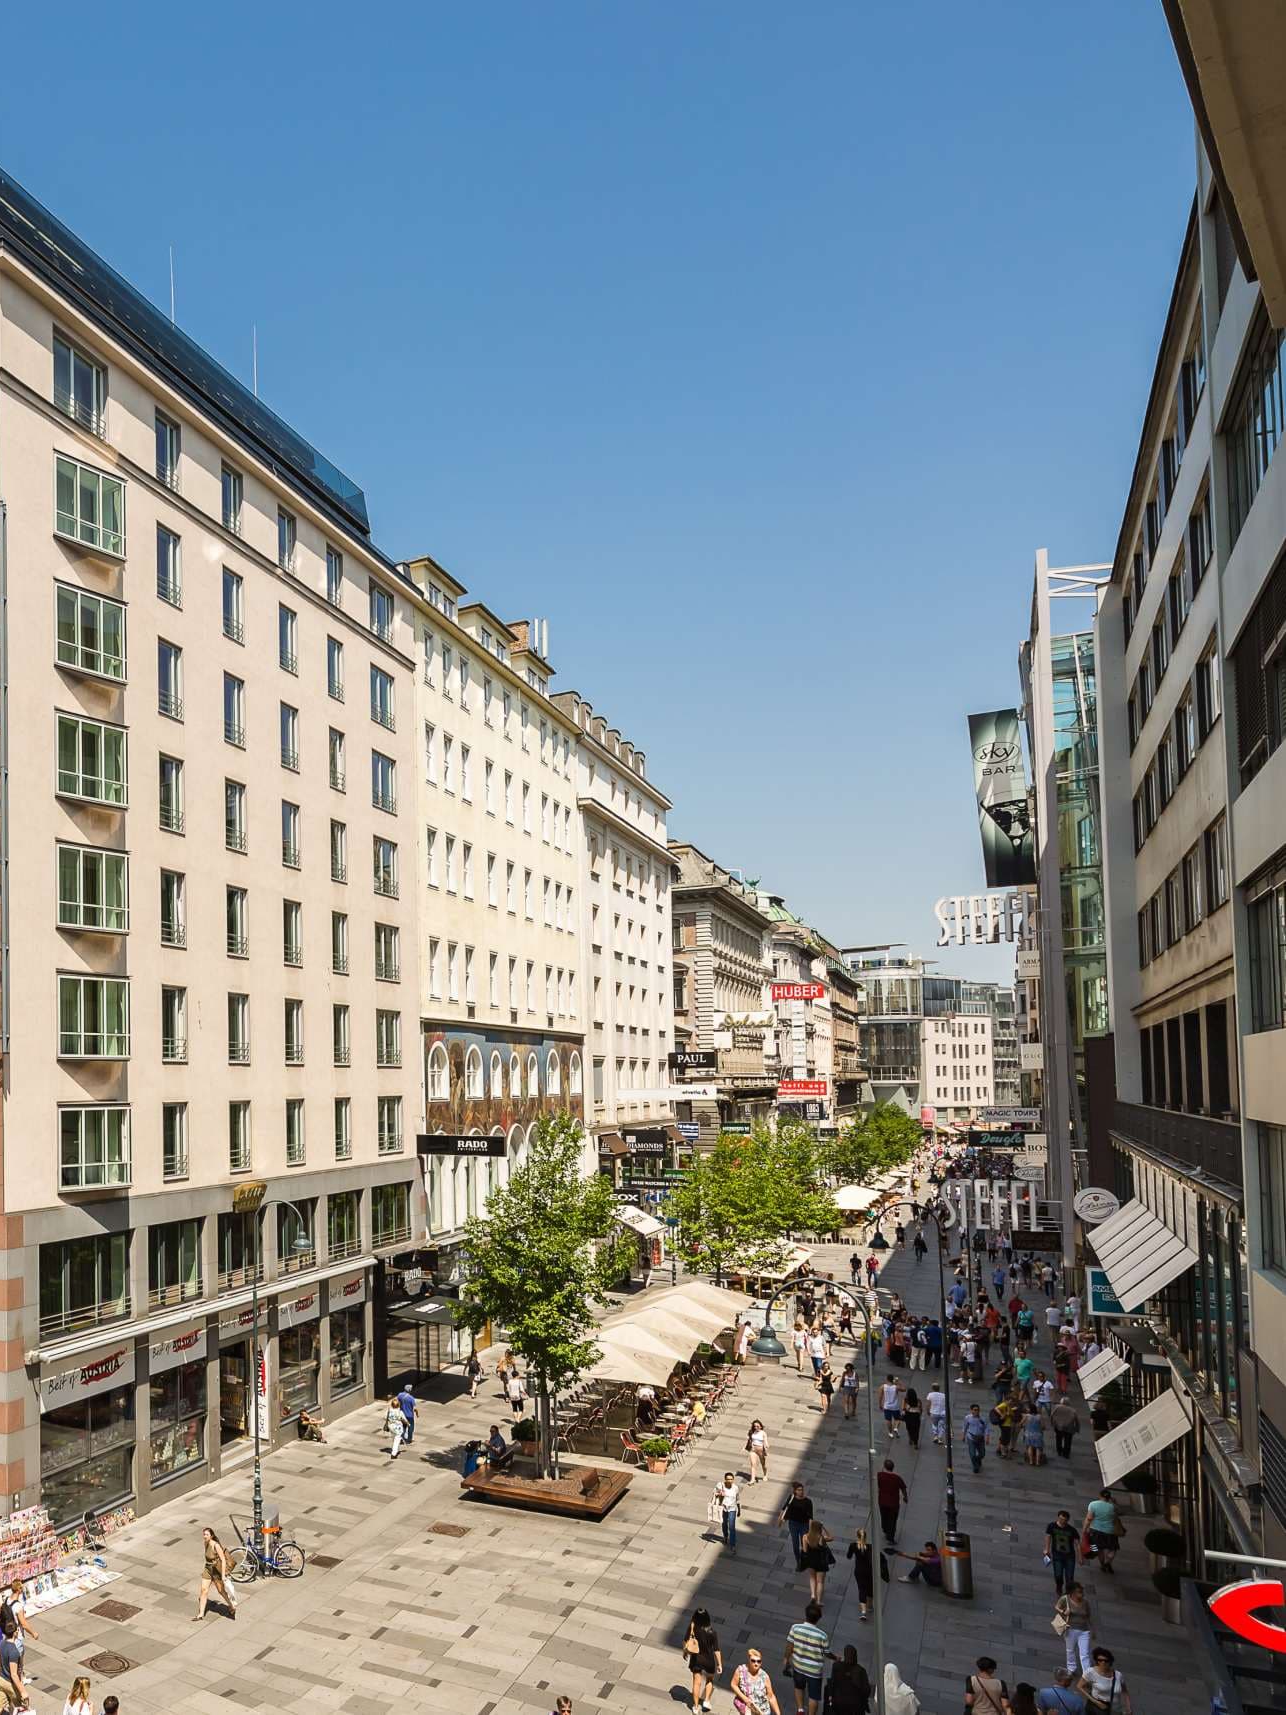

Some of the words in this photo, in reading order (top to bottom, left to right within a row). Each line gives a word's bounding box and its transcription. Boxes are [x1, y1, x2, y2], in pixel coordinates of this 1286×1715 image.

[980, 742, 1015, 760] sky
[982, 765, 1016, 776] BAR
[935, 891, 1036, 946] STEFFL
[774, 985, 819, 997] HUBER
[677, 1054, 706, 1063] PAUL
[457, 1140, 488, 1148] RADO
[980, 1133, 1022, 1145] Dougla
[940, 1178, 1044, 1232] STEFFL
[79, 1355, 125, 1382] AUSTRIA
